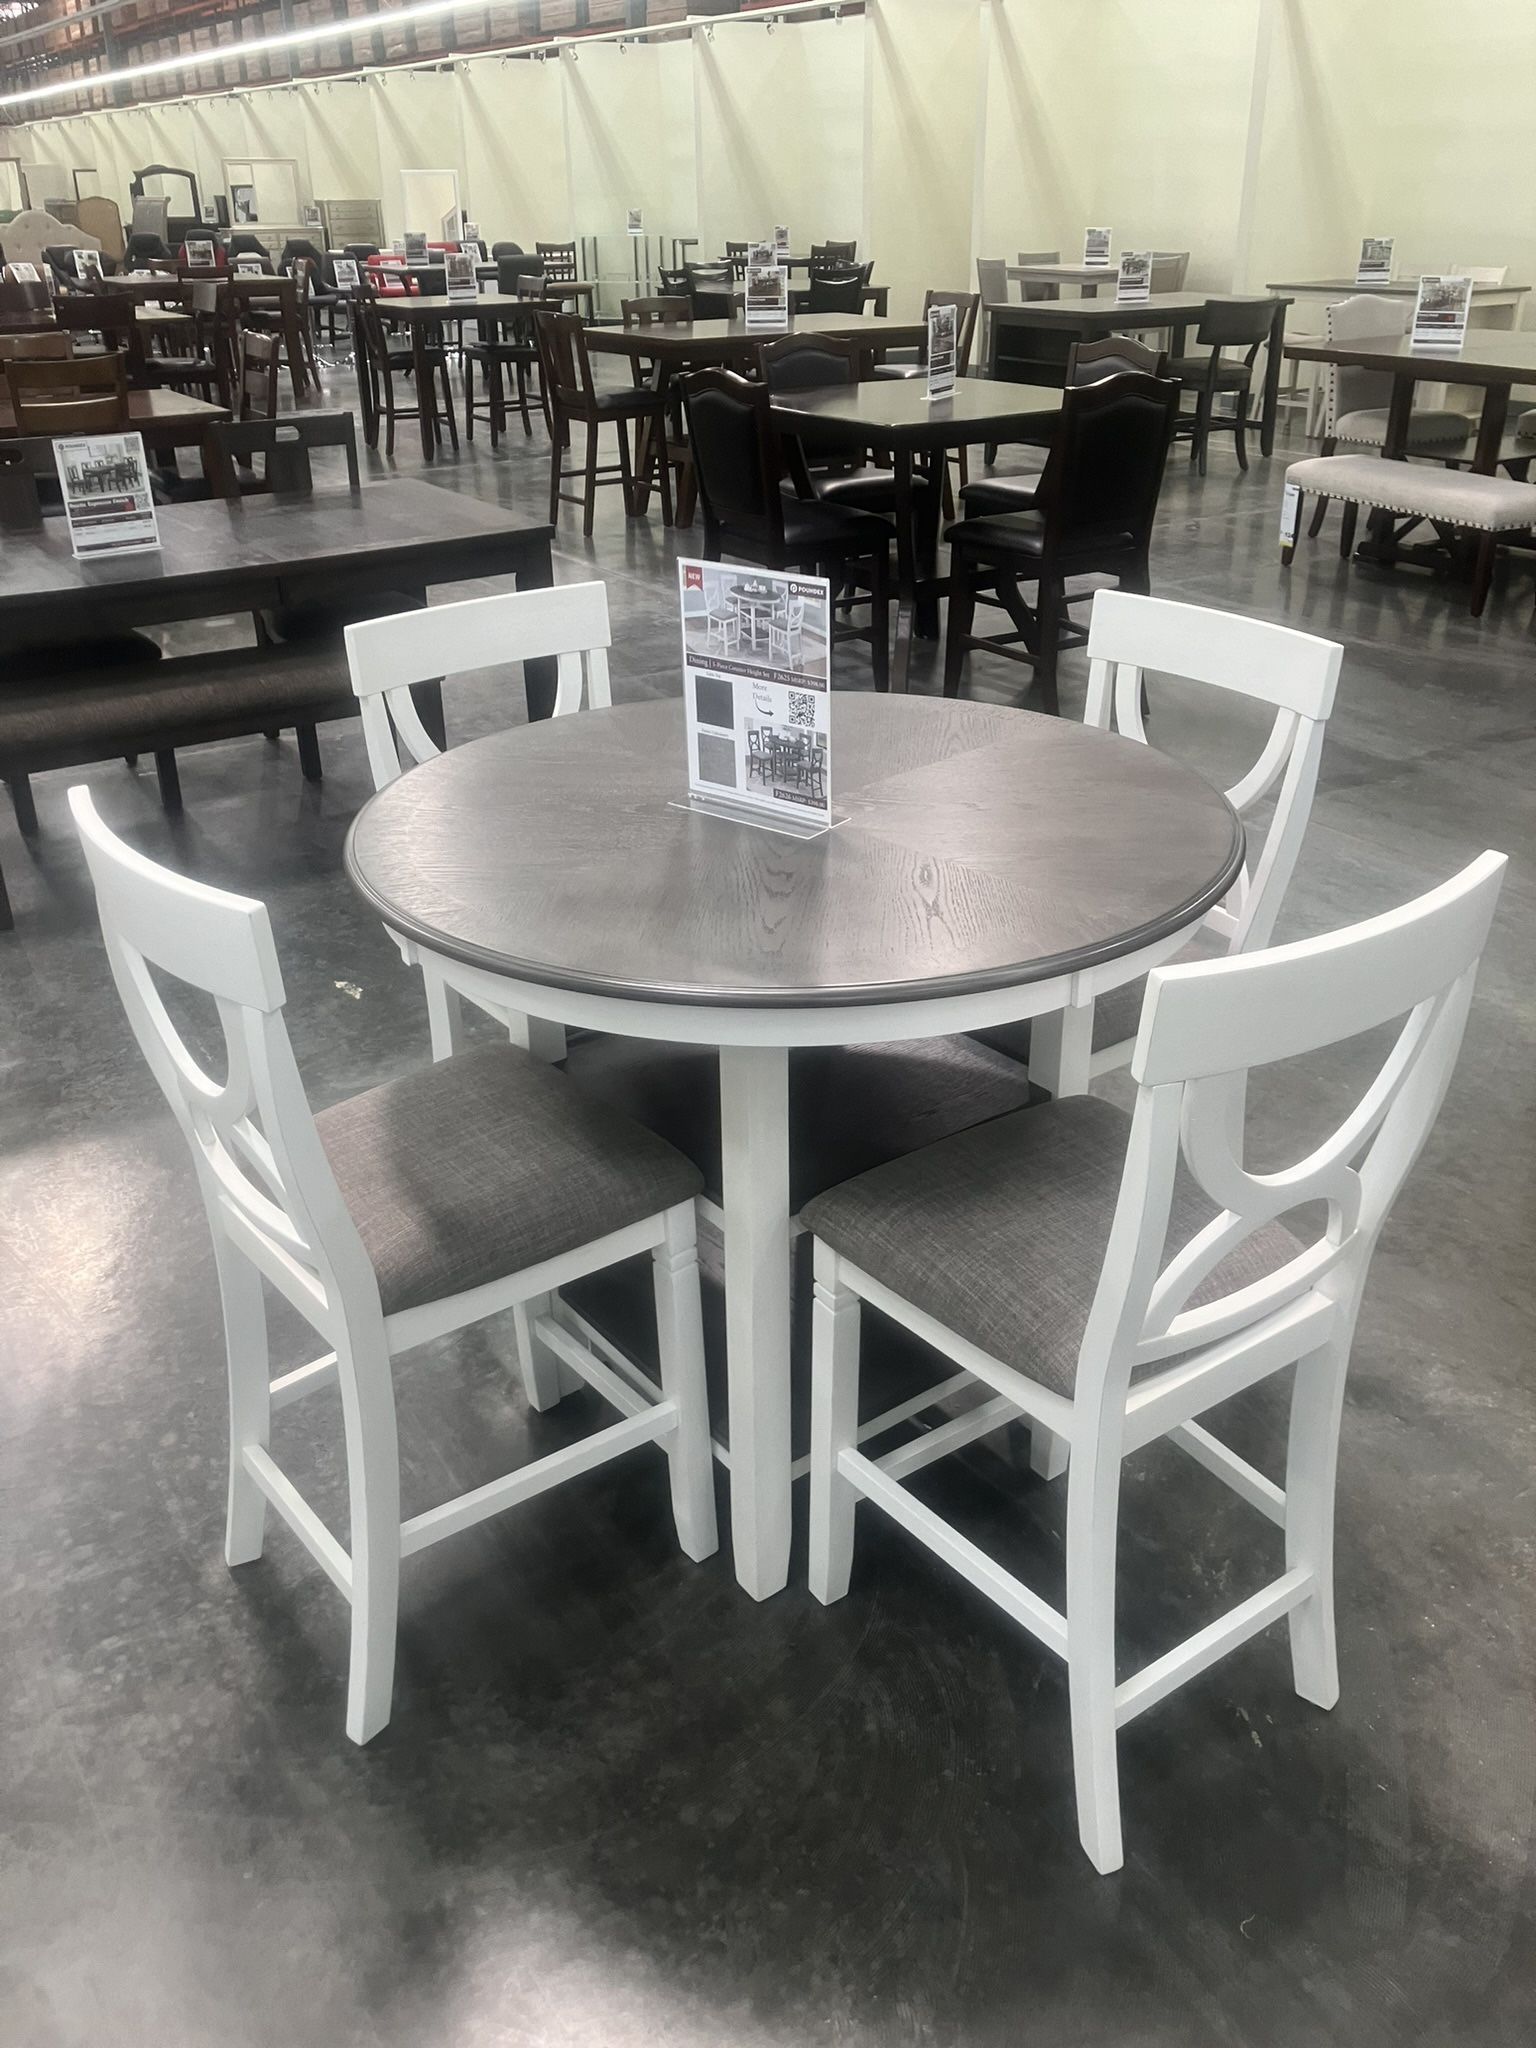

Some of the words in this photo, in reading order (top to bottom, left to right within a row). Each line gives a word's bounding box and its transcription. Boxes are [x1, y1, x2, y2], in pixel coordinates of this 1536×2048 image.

[688, 572, 701, 580] NEW
[798, 586, 824, 595] POUNDEX
[689, 655, 708, 668] Dining
[752, 682, 767, 691] More
[752, 693, 773, 703] Details
